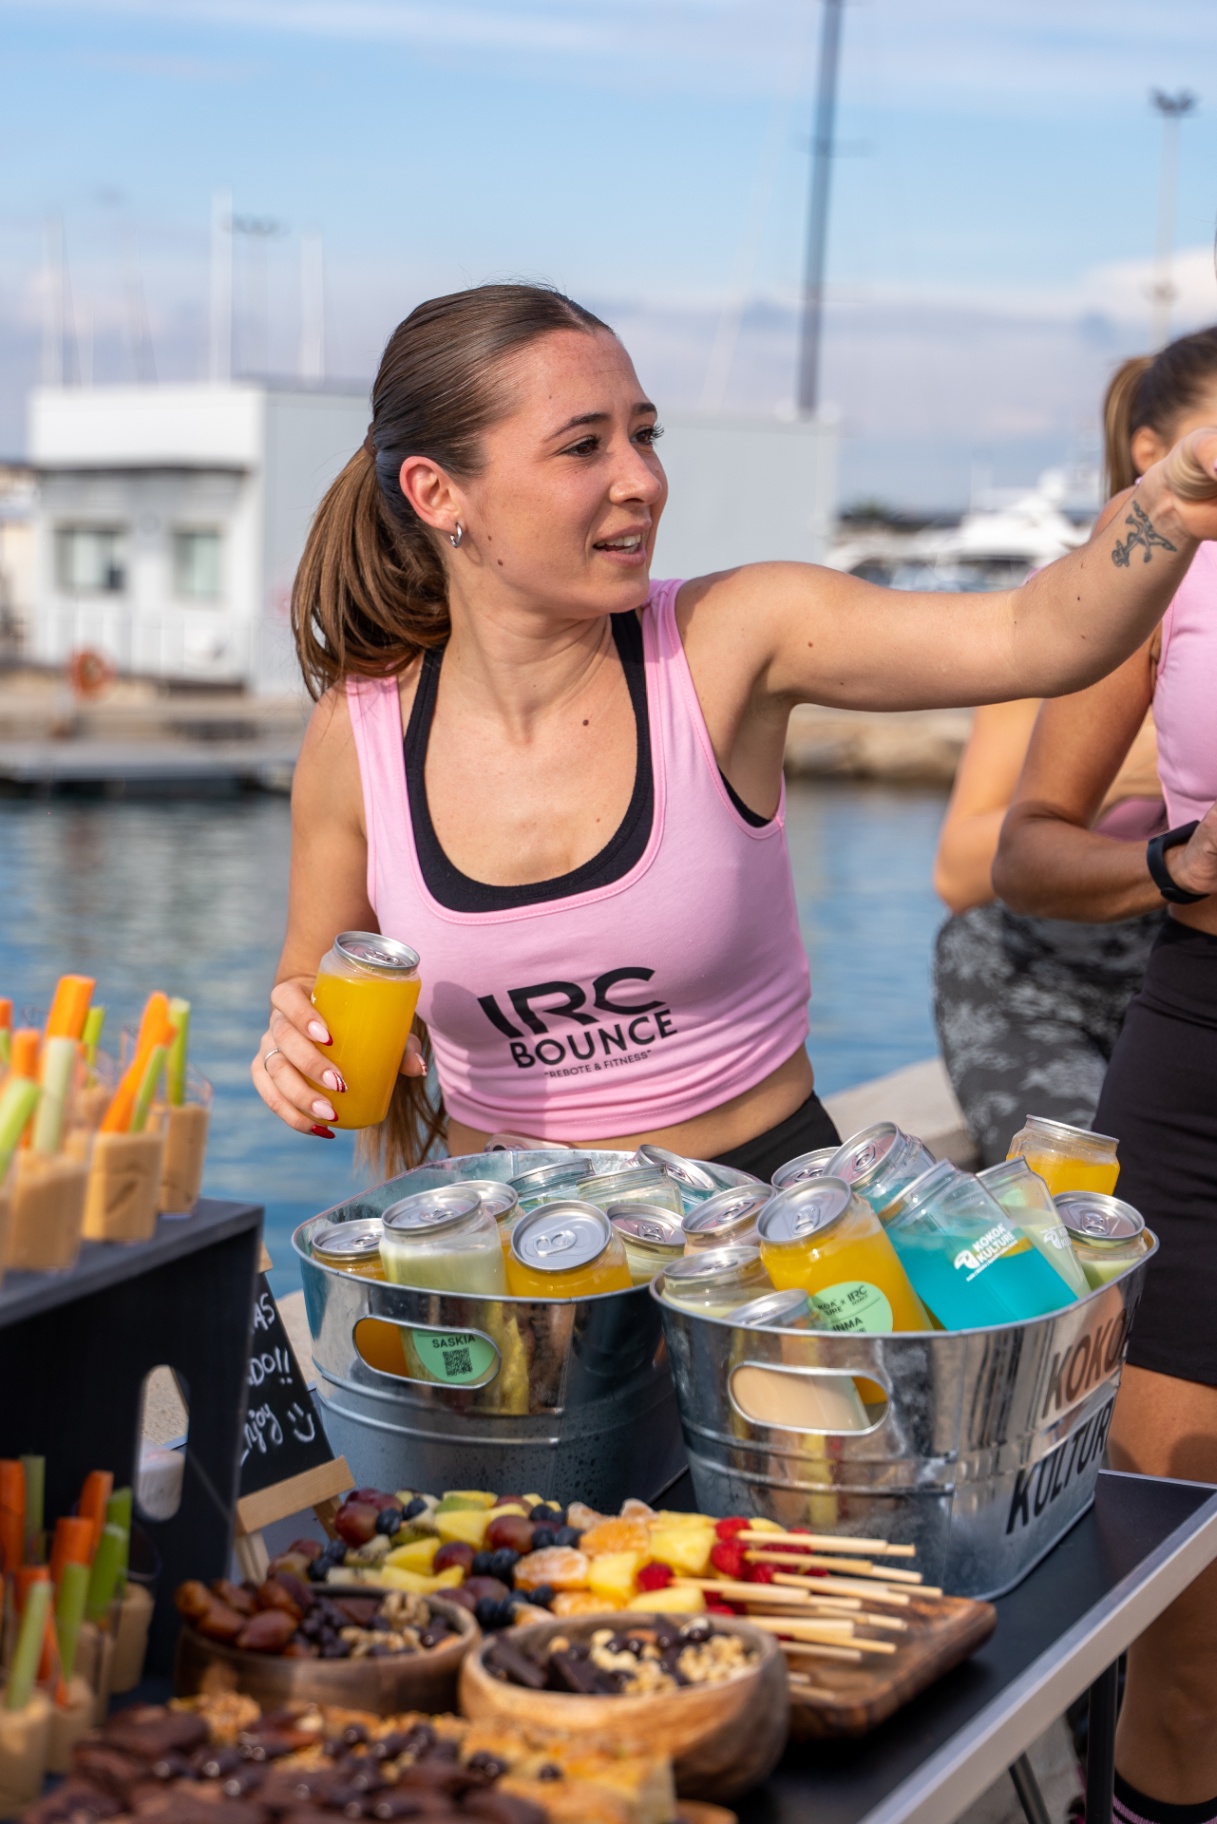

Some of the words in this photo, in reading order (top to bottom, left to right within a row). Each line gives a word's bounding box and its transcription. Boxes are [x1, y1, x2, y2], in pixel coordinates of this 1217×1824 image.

[477, 967, 666, 1038] IRC
[509, 1009, 678, 1068] BOUNCE
[594, 1063, 602, 1072] &
[977, 1231, 1016, 1263] KULTURE
[252, 1293, 275, 1333] AS
[847, 1285, 868, 1302] IRC
[432, 1334, 476, 1348] SASKIA
[248, 1346, 293, 1386] DO!!
[1042, 1308, 1130, 1419] KOKO
[1006, 1397, 1115, 1535] KULTUR
